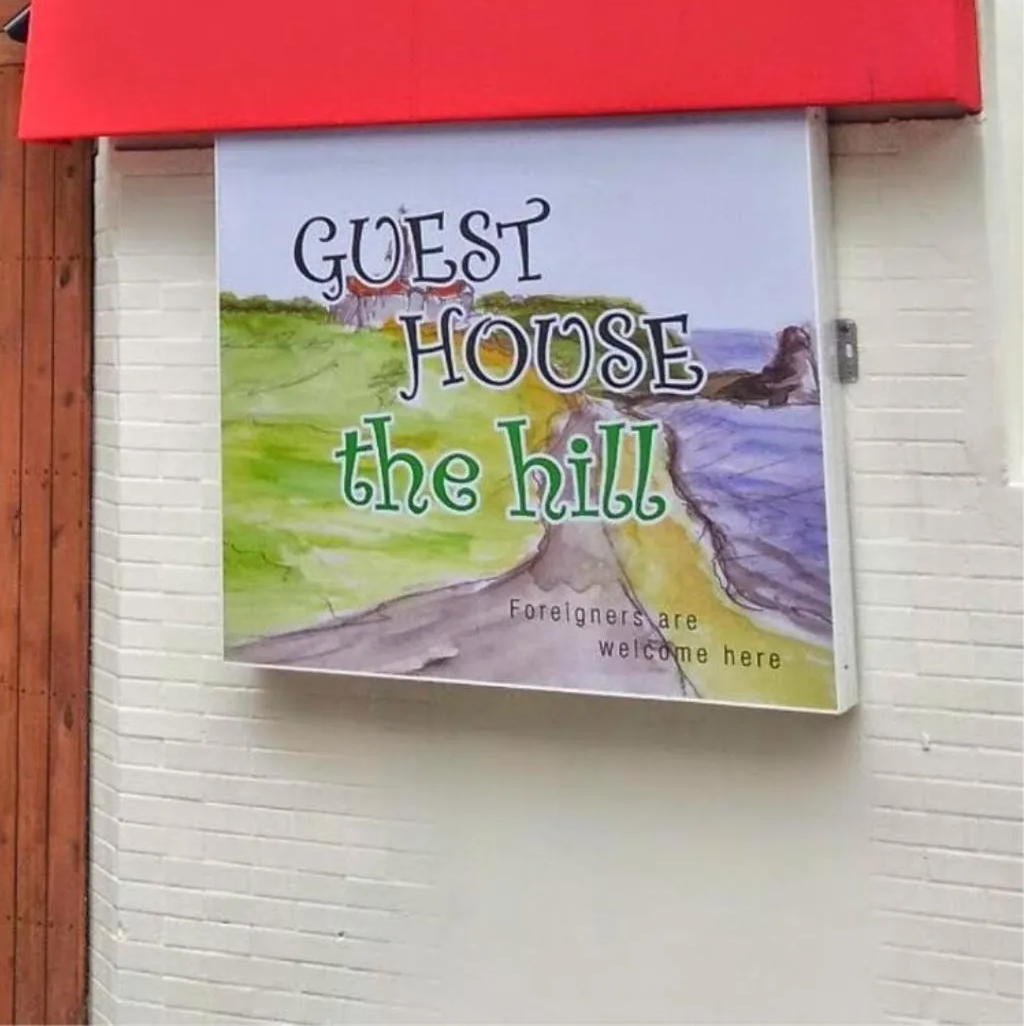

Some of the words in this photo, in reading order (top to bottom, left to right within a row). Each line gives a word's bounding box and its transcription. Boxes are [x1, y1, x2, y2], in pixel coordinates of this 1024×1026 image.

[293, 197, 551, 300] GUEST
[398, 305, 705, 401] HOUSE
[334, 415, 481, 514] the
[497, 417, 667, 521] hill
[509, 598, 644, 627] Foreigners
[658, 609, 698, 630] are
[598, 638, 708, 664] welcome
[723, 645, 782, 669] here
